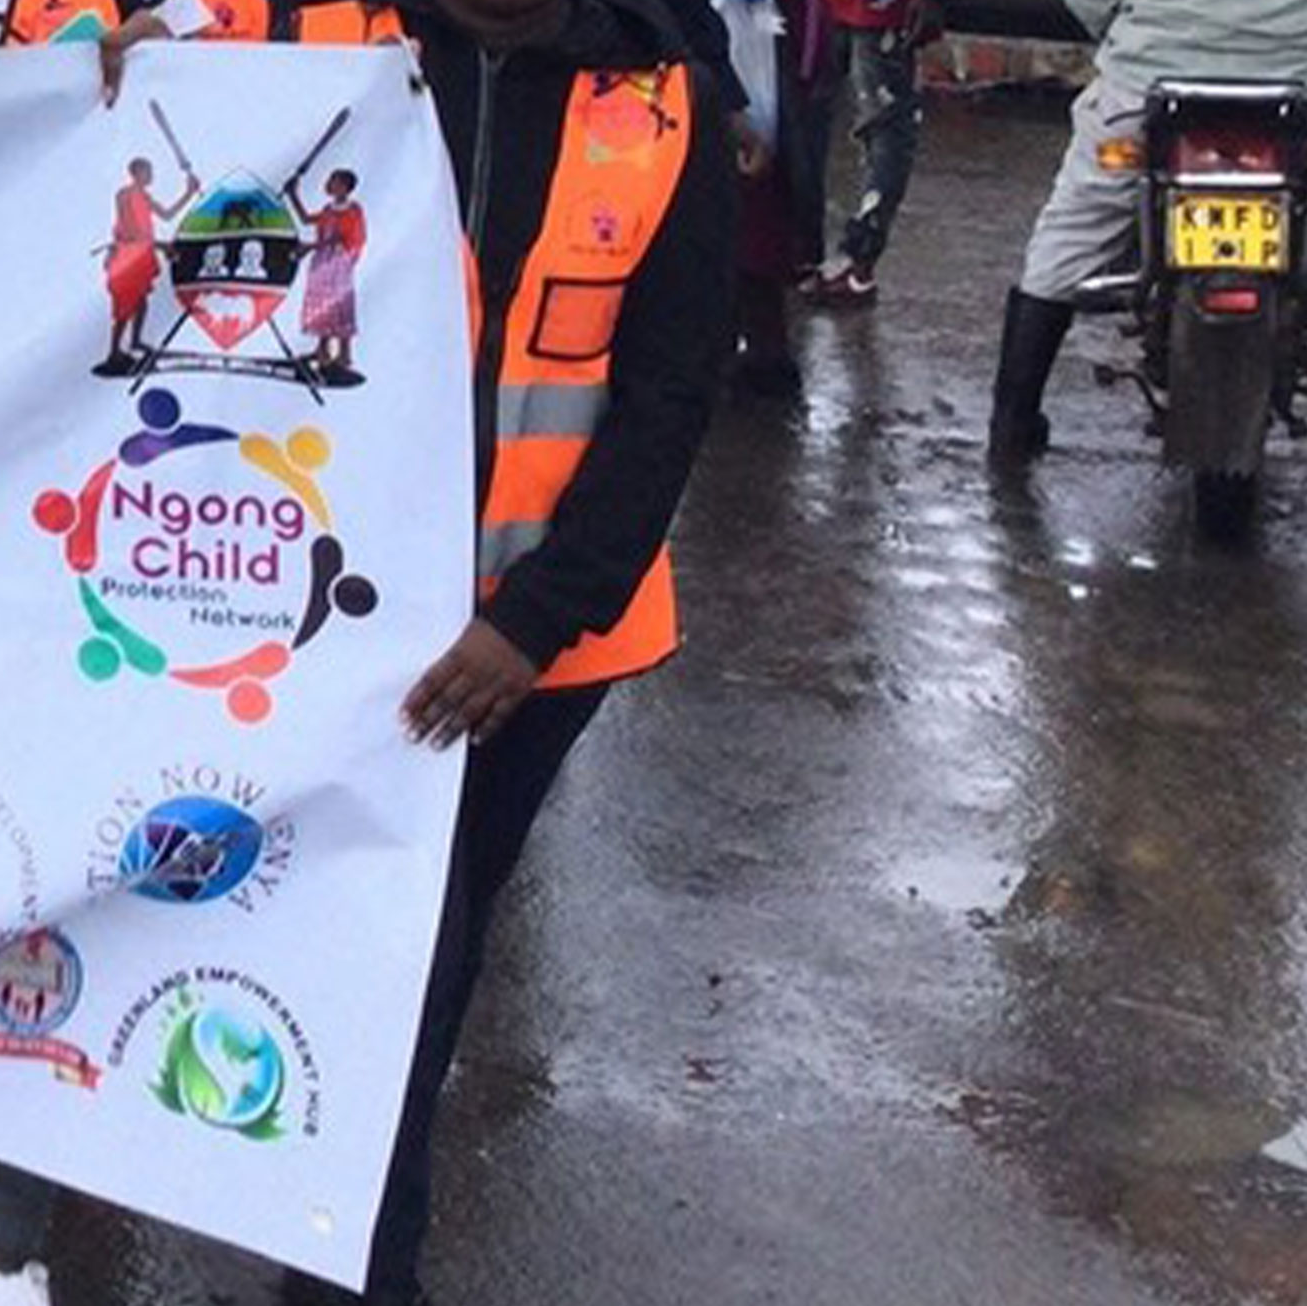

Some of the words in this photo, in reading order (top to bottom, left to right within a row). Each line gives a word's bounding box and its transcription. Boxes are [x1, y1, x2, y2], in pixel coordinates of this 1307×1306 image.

[112, 481, 305, 542] Ngong
[132, 537, 279, 584] Child
[100, 576, 228, 603] Protection
[189, 607, 295, 631] Network
[158, 764, 266, 808] NOW
